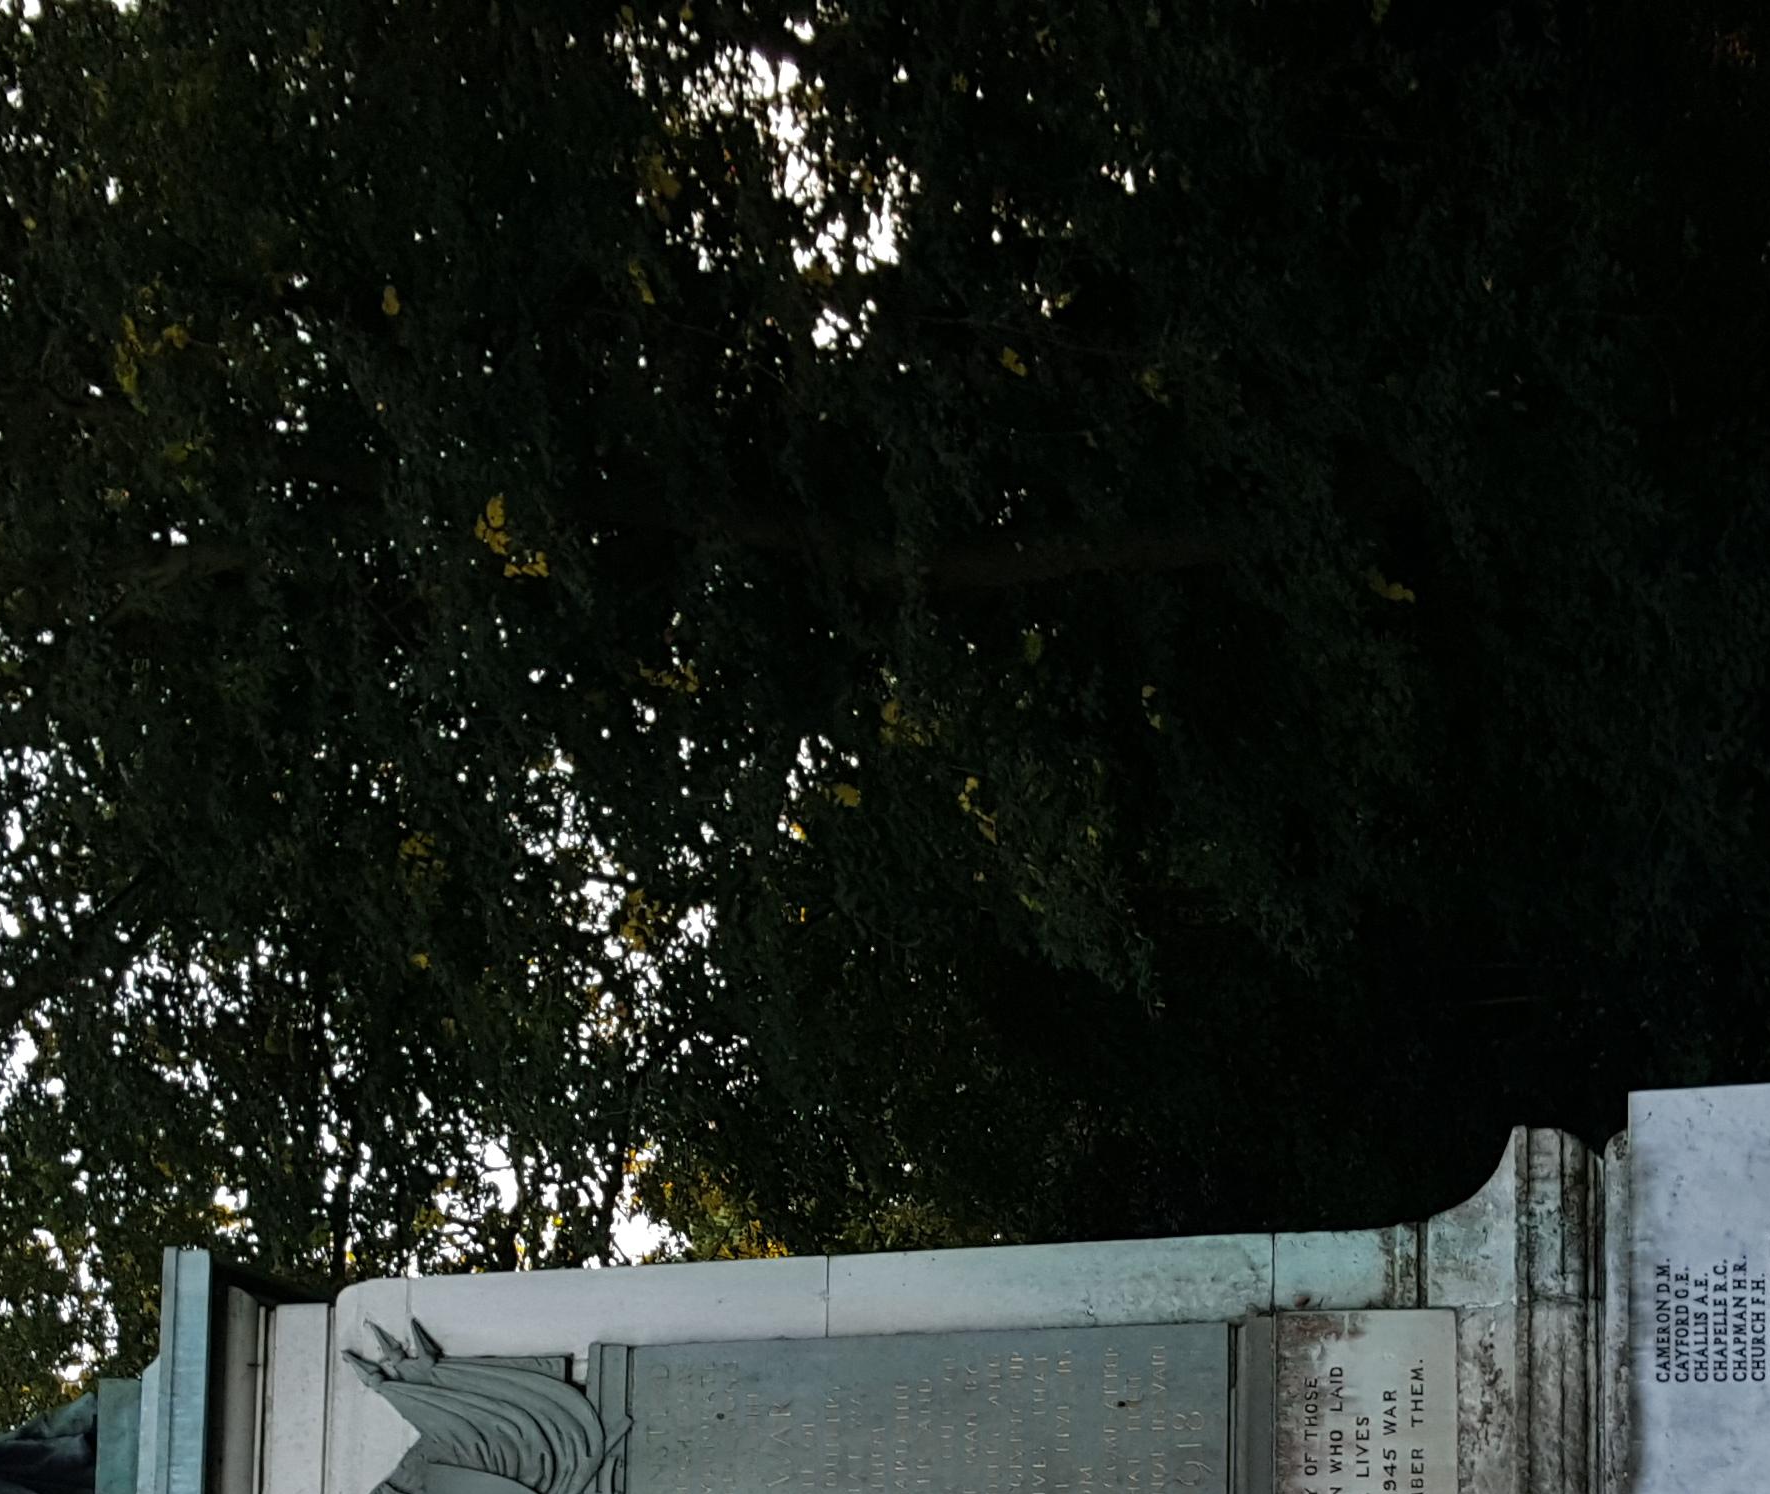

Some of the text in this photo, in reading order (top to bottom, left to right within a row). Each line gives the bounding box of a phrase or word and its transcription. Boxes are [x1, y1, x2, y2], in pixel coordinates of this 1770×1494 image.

[1656, 1258, 1670, 1383] CAMERON D.M.
[1674, 1266, 1689, 1383] CAYFORD G.E.
[1694, 1273, 1708, 1382] CHALLIS A.E.
[1713, 1259, 1728, 1382] CHAPELLE R.C.
[1733, 1254, 1747, 1382] CHAPMAN H.R.
[1751, 1273, 1765, 1382] CHURCH F.H.
[1304, 1377, 1320, 1441] THOSE
[1329, 1367, 1345, 1412] LAID
[1383, 1390, 1397, 1436] WAR
[1410, 1360, 1424, 1428] THEM.
[1304, 1453, 1319, 1476] OF
[1329, 1430, 1343, 1474] WHO
[1355, 1416, 1370, 1478] LIVES
